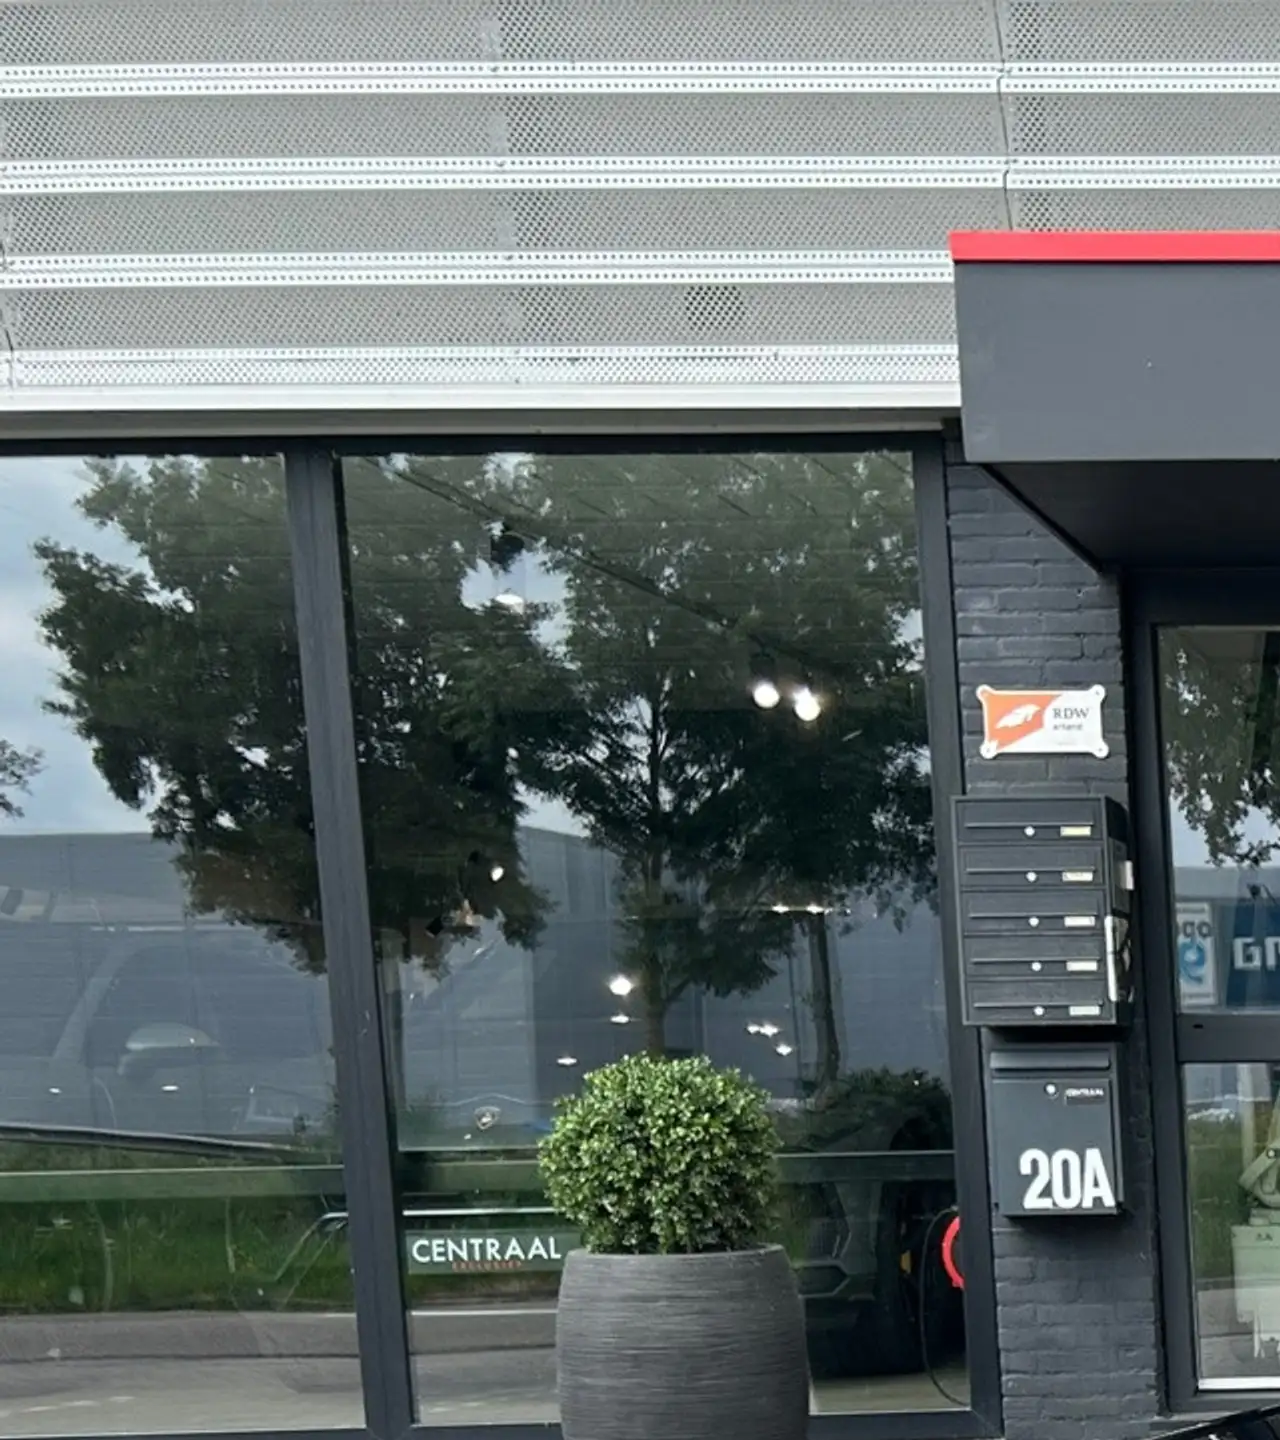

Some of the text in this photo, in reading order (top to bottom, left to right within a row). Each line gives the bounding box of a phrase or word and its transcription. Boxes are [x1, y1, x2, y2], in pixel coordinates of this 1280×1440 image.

[1052, 707, 1089, 719] RDW
[1019, 1147, 1116, 1209] 20A
[411, 1235, 562, 1263] CENTRAAL
